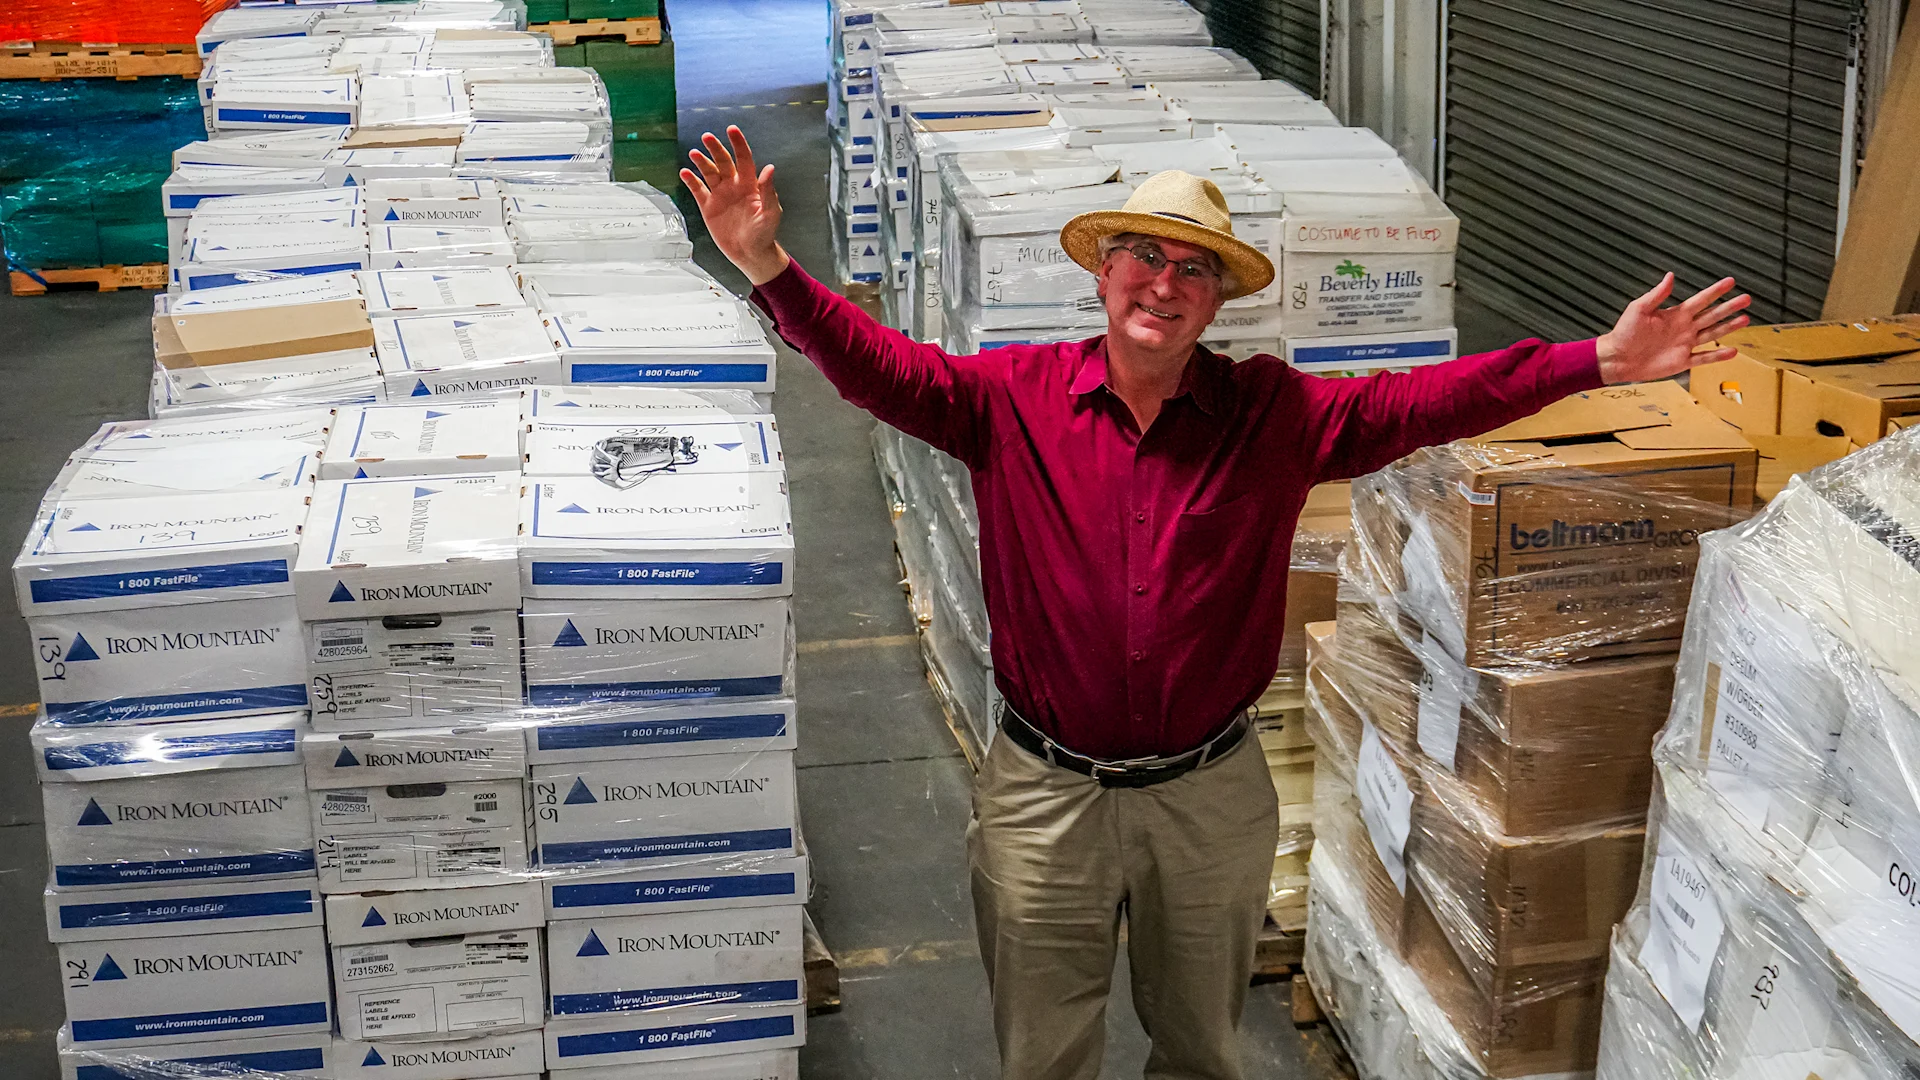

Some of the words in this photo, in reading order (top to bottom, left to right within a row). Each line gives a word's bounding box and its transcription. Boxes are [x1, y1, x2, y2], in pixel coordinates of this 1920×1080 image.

[402, 211, 425, 220] IRON
[924, 198, 938, 227] 745
[1297, 225, 1362, 242] COSTUME
[1364, 226, 1380, 240] TO
[1386, 225, 1400, 241] BE
[1406, 226, 1442, 242] FILED
[1319, 273, 1380, 293] Beverly
[1385, 270, 1424, 289] Hills
[1292, 281, 1308, 310] 750
[637, 369, 643, 377] 1
[645, 368, 663, 377] 800
[434, 383, 465, 396] IRON
[596, 505, 645, 515] IRON
[109, 522, 159, 531] IRON
[350, 514, 383, 537] 259
[741, 525, 780, 534] Legal
[139, 530, 196, 544] 139
[1509, 519, 1654, 551] beltmann
[617, 569, 624, 579] 1
[626, 568, 649, 579] 800
[118, 579, 125, 589] 1
[128, 577, 151, 588] 800
[360, 587, 401, 601] IRON
[595, 626, 645, 645] IRON
[106, 636, 157, 655] IRON
[317, 644, 368, 658] 428025964
[38, 636, 67, 682] 139
[312, 673, 338, 715] 259
[109, 696, 243, 714] www.ironmountain.com
[622, 729, 628, 738] 1
[631, 728, 652, 738] 800
[365, 753, 403, 768] IRON
[473, 792, 497, 800] #2000
[603, 784, 652, 802] IRON
[321, 801, 371, 813] 428025931
[537, 781, 559, 824] 295
[117, 803, 166, 822] IRON
[603, 838, 731, 855] www.ironmountain.com
[119, 861, 251, 877] www.ironmountain.com
[635, 887, 641, 897] 1
[643, 886, 665, 896] 800
[155, 905, 177, 915] 800
[393, 911, 432, 925] IRON
[617, 936, 665, 954] IRON
[66, 958, 90, 989] 291
[133, 957, 184, 976] IRON
[346, 962, 395, 977] 273152662
[135, 1012, 264, 1031] www.ironmountain.com
[638, 1035, 644, 1045] 1
[647, 1034, 668, 1044] 800
[392, 1053, 428, 1068] IRON
